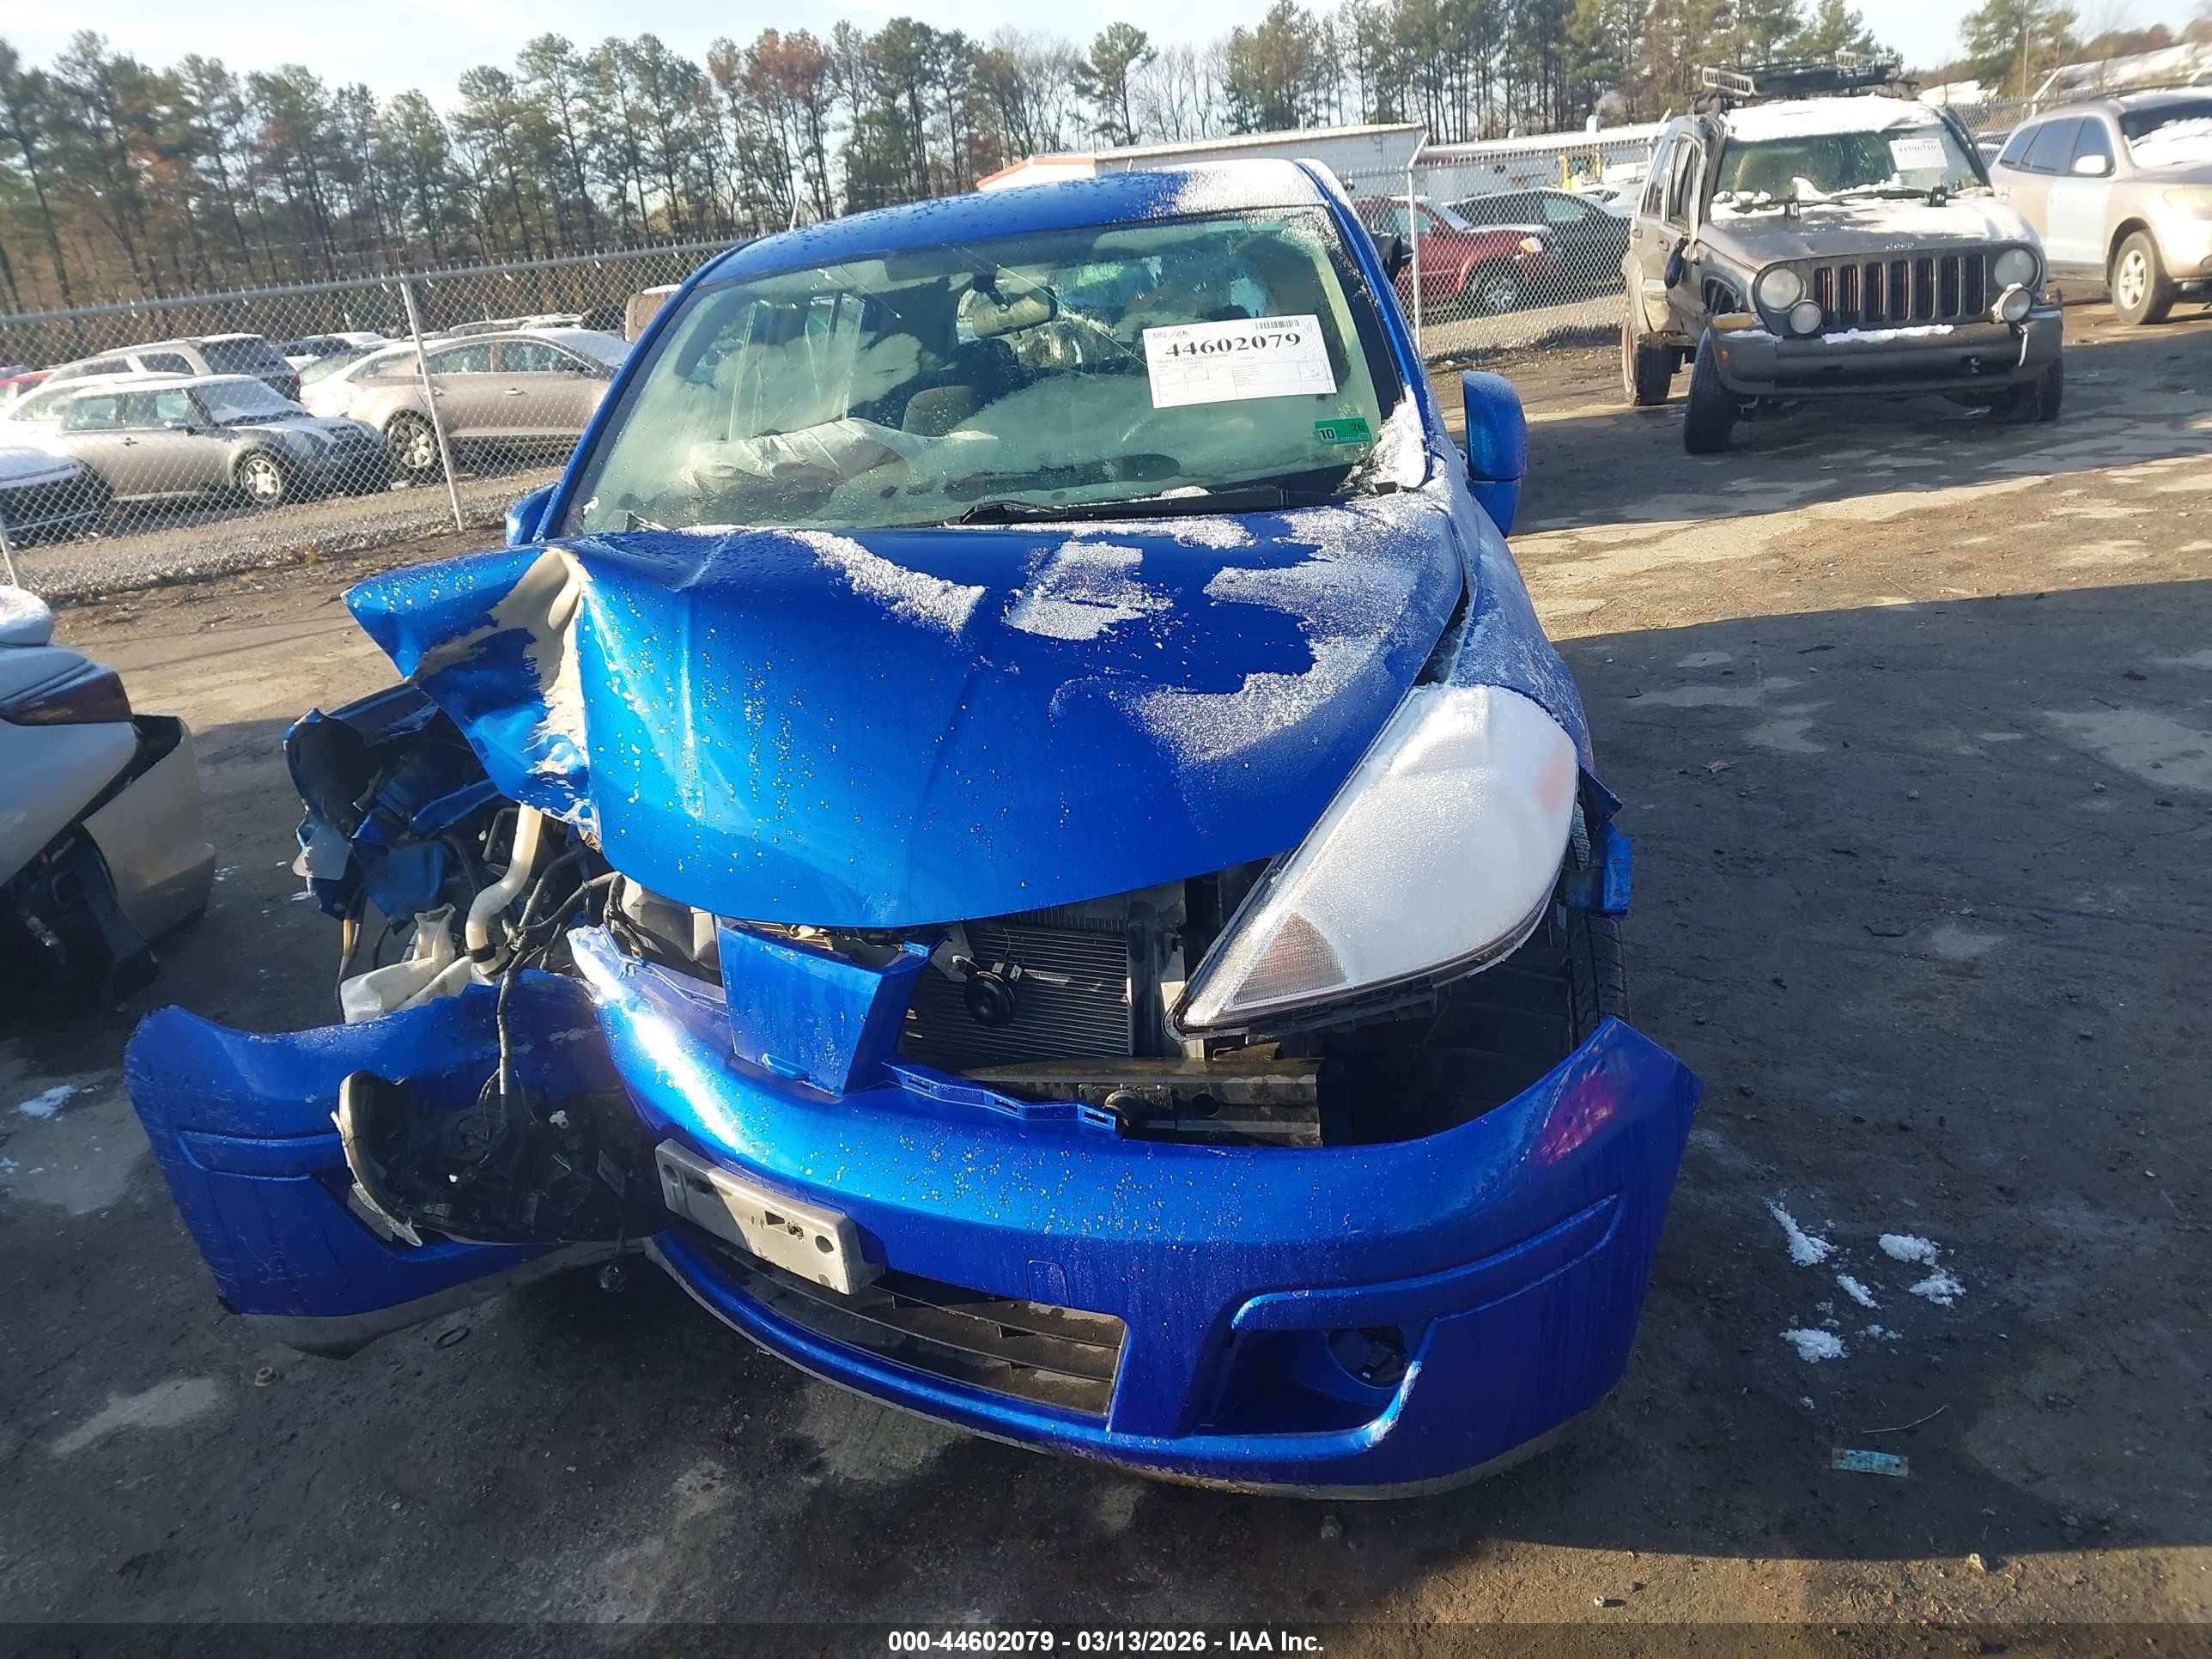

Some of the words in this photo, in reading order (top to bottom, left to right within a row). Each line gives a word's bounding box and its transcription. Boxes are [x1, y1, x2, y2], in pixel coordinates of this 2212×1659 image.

[1165, 332, 1301, 356] 44602079
[1350, 422, 1364, 432] 26
[1319, 428, 1335, 440] 10
